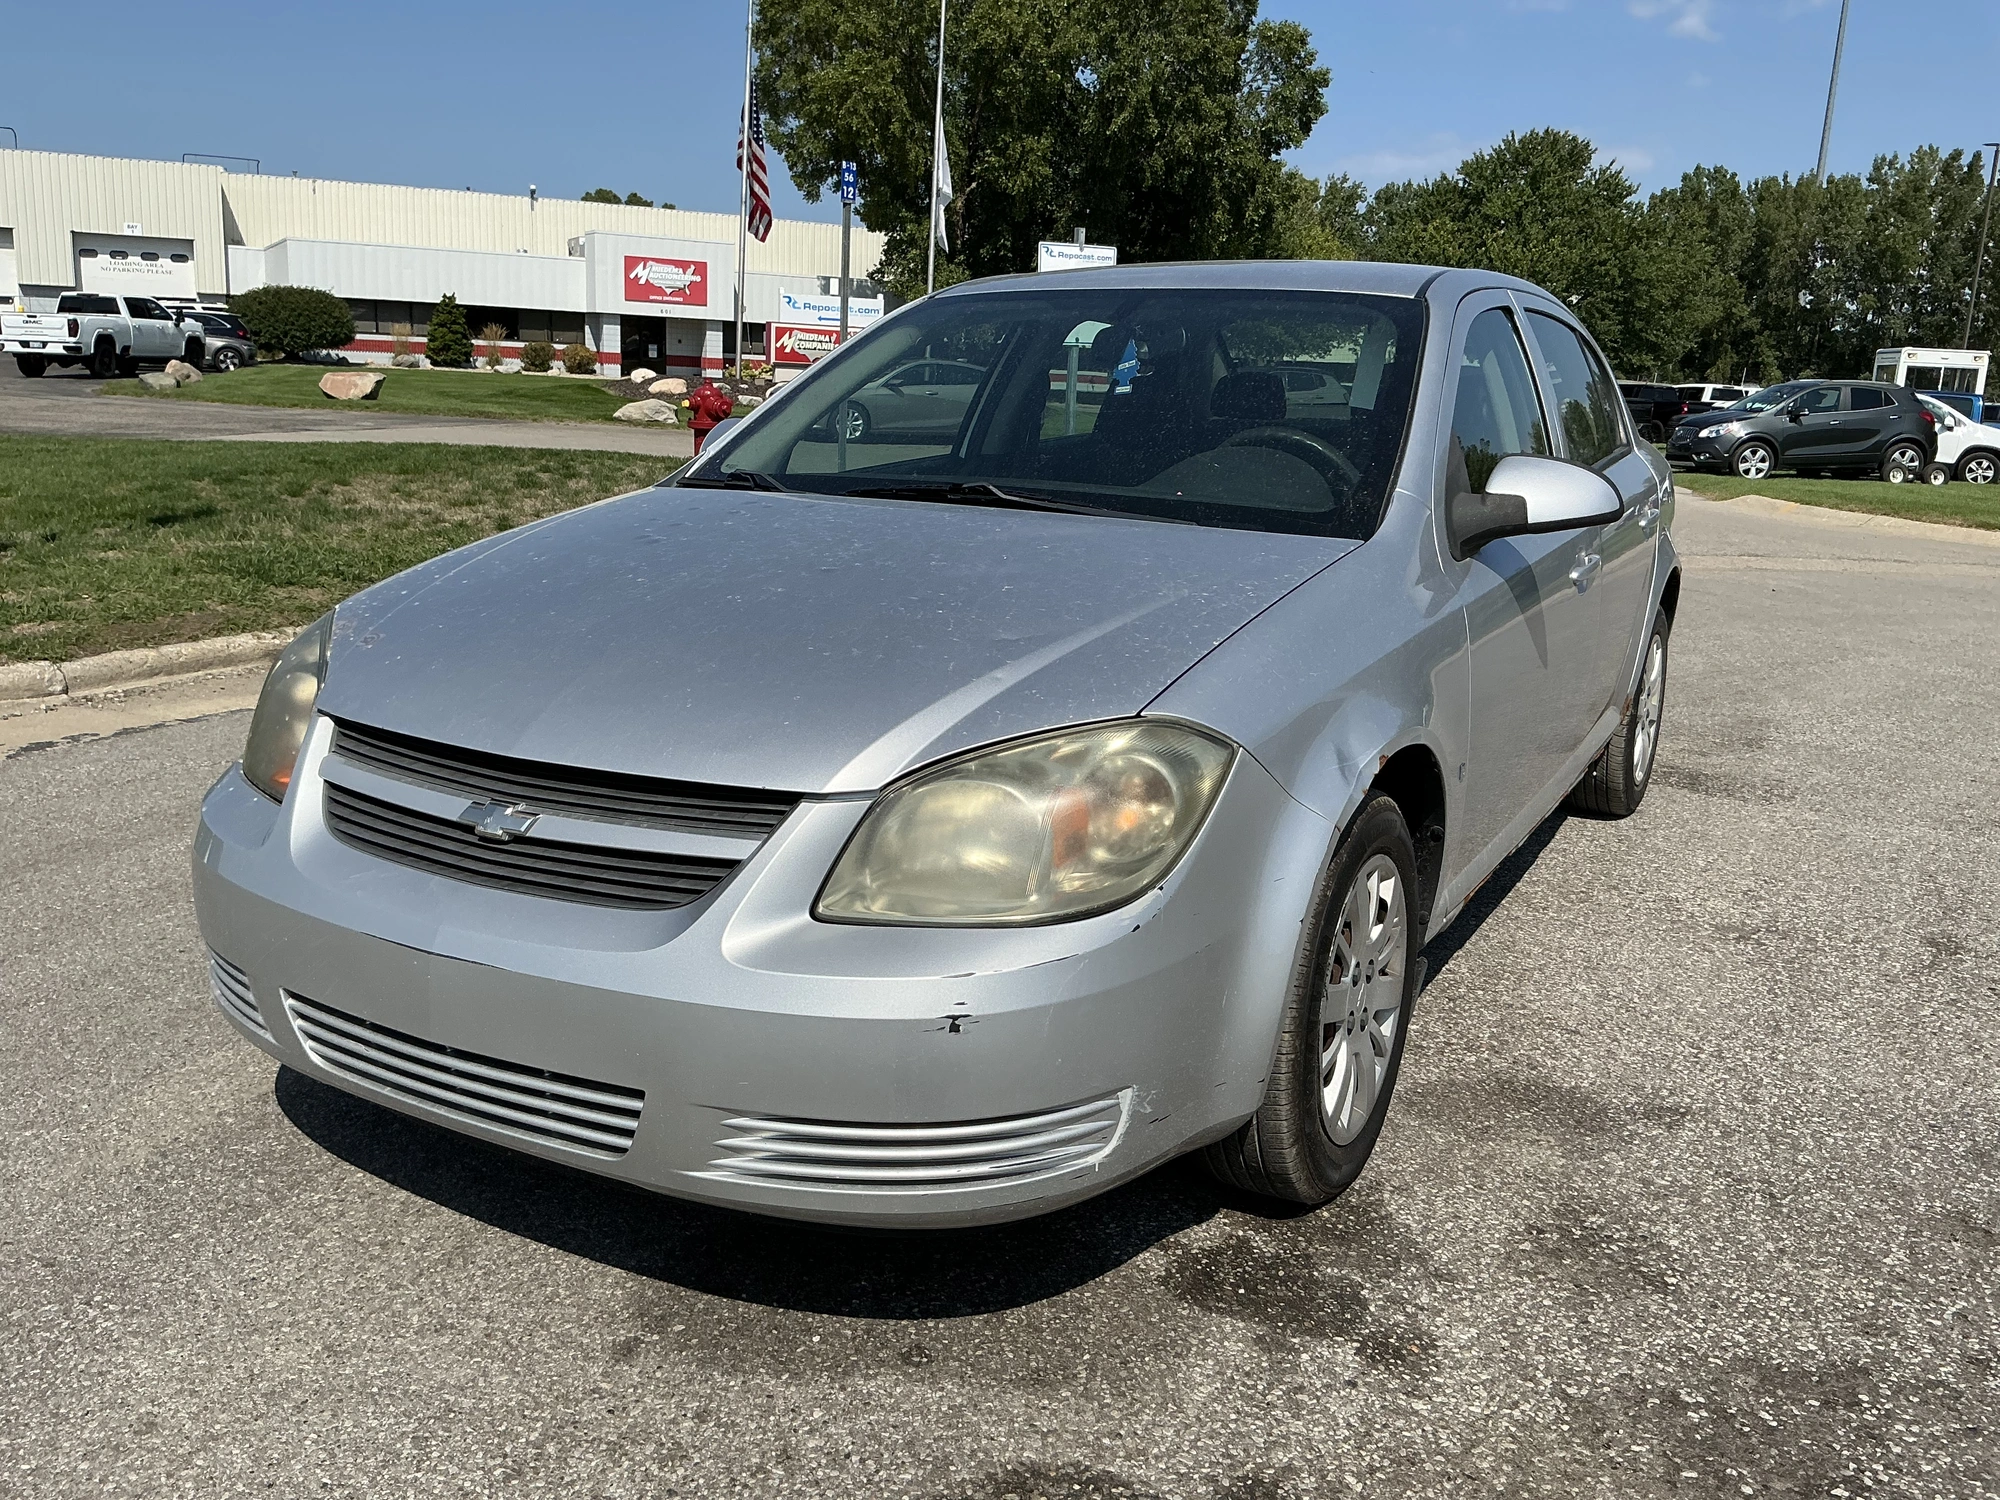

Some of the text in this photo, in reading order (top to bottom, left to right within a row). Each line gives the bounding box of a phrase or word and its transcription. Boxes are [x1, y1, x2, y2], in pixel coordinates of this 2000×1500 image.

[843, 172, 854, 183] 56
[842, 185, 854, 199] 12
[1057, 251, 1112, 262] Repocast.com
[109, 260, 143, 268] LOADING
[147, 268, 174, 276] PLEASE
[651, 266, 683, 275] MIEDEMA
[649, 272, 702, 283] AUCTIONEERING
[803, 302, 880, 315] Repocat.com
[796, 333, 830, 342] MIEDEMA
